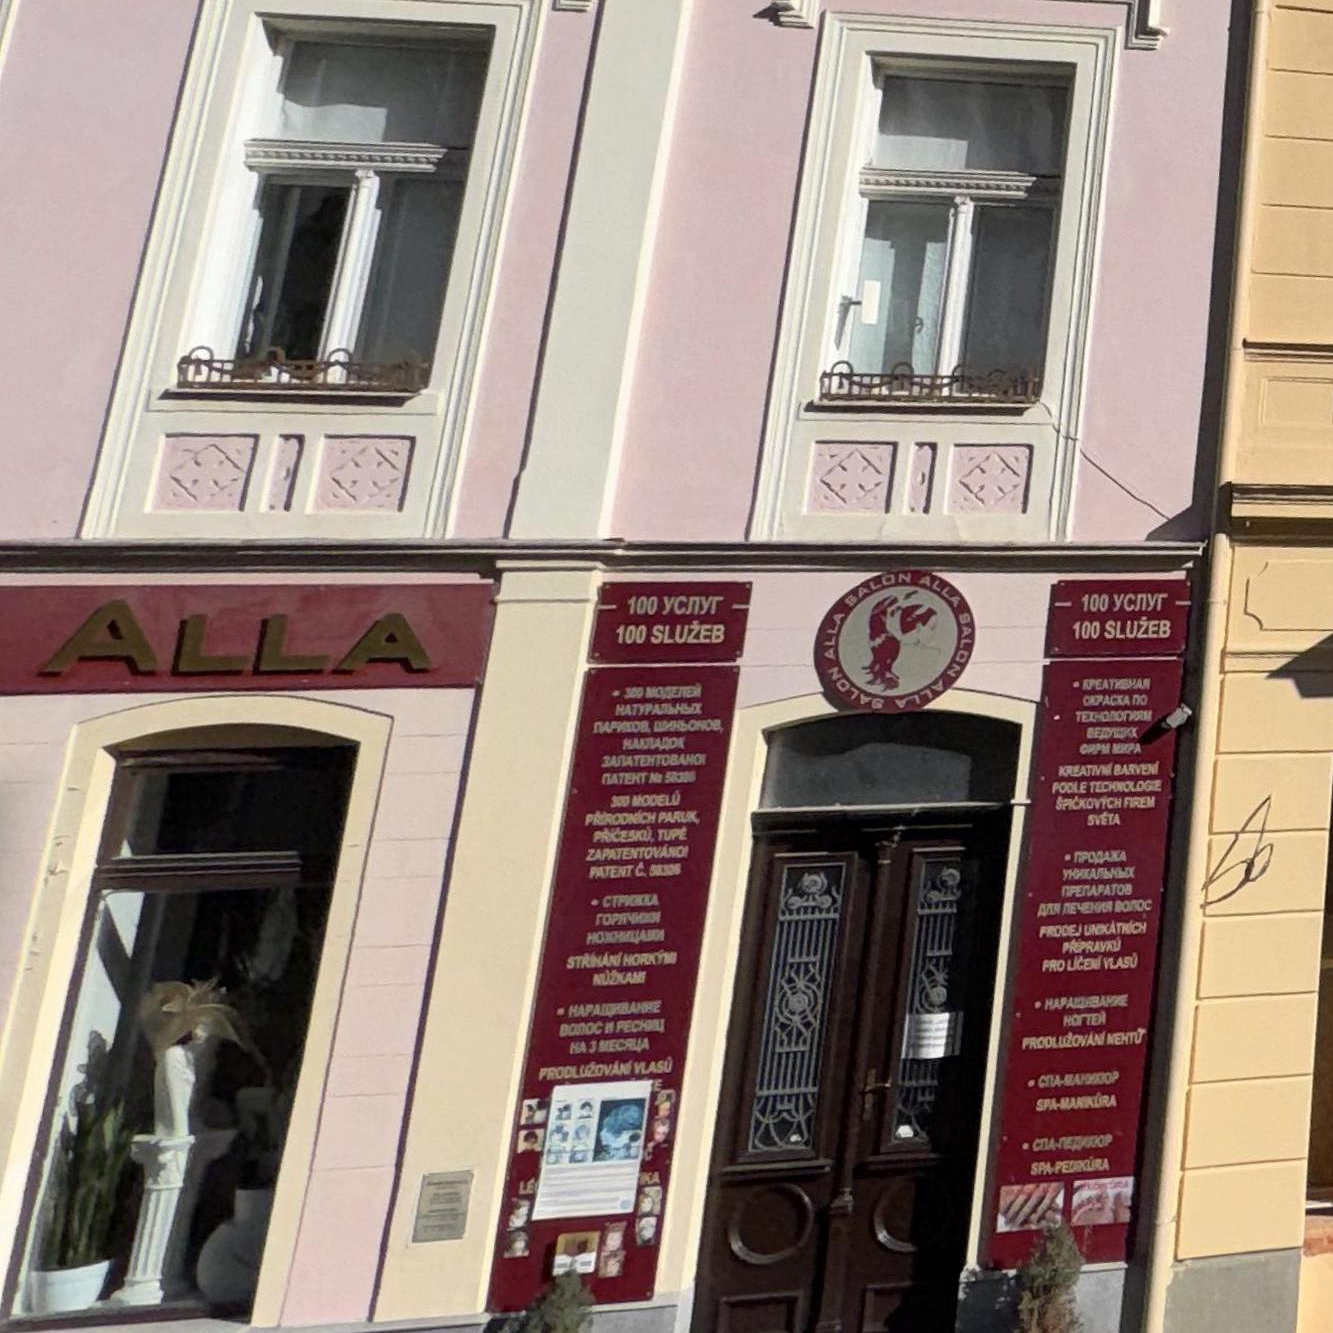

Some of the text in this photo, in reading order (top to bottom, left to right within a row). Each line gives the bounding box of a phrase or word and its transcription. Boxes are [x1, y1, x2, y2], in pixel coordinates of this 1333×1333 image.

[627, 596, 724, 615] 100 УСЛУГ
[1081, 593, 1168, 612] 100 УСЛУГ
[616, 620, 725, 644] 100 SLUŽEB
[1072, 616, 1172, 639] 100 SLUŽEB
[36, 599, 432, 677] ALLA
[824, 573, 975, 709] SALON ALLA SALON ALLA SALON ALLA
[1082, 678, 1151, 690] КРЕАТИВНАЯ
[1132, 694, 1149, 706] ПО
[615, 703, 702, 716] НАТУРАЛЬНЫХ
[1058, 761, 1160, 777] KREATIVNÍ BARVENÍ
[602, 772, 647, 785] ПАТЕНТ
[1052, 781, 1088, 795] PODLE
[631, 789, 681, 807] MODELŮ
[1123, 796, 1156, 809] FIREM
[1073, 850, 1127, 864] ПРОДАЖА
[589, 864, 634, 879] PATENT
[1062, 866, 1136, 881] УНИКАЛЬНЫХ
[1062, 884, 1133, 897] ПРЕПАРАТОВ
[1037, 899, 1153, 917] ДЛЯ ЛЕЧЕНИЯ ВОЛОС
[1039, 924, 1082, 938] PRODEJ
[1042, 959, 1065, 972] PRO
[1103, 952, 1139, 970] VLASŮ
[1063, 1010, 1106, 1027] НОГТЕЙ
[559, 1023, 603, 1038] ВОЛОС
[1022, 1027, 1146, 1050] PRODLUŽOVÁNÍ NEHTŮ
[569, 1041, 587, 1055] НА
[539, 1056, 673, 1081] PRODLUŽOVÁNÍ VLASŮ
